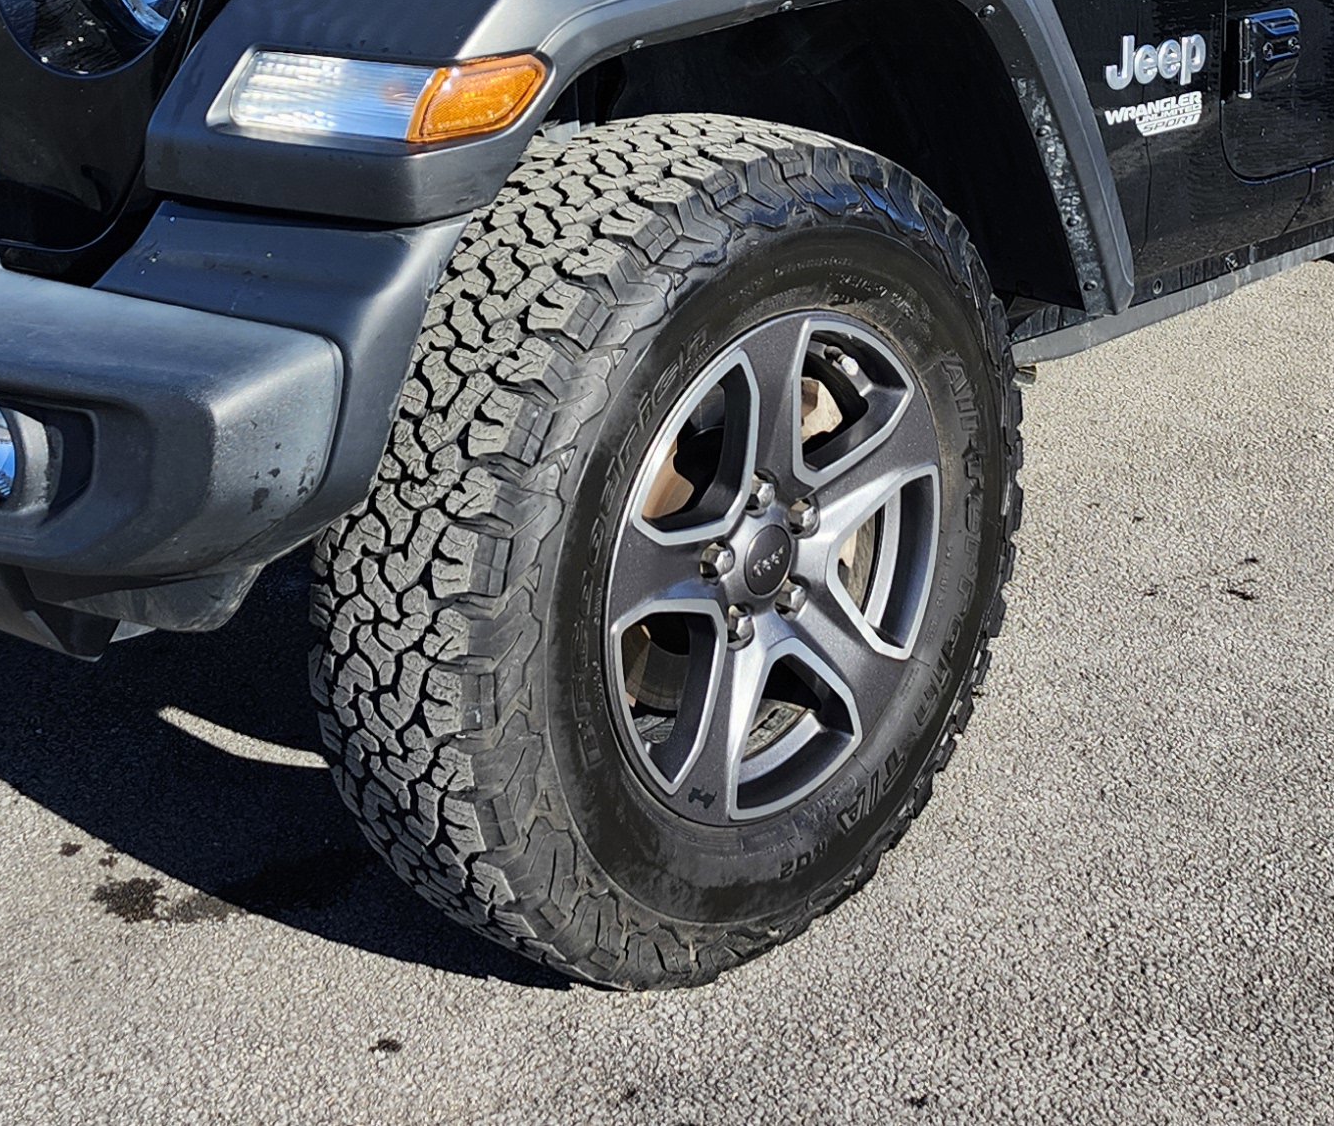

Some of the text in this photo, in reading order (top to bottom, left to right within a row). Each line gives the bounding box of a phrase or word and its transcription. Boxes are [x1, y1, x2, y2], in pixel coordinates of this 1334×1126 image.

[1105, 33, 1206, 90] Jeep
[1104, 90, 1203, 125] WRANGLER
[1135, 103, 1203, 123] UNLIMITED
[1141, 114, 1199, 132] SPORT
